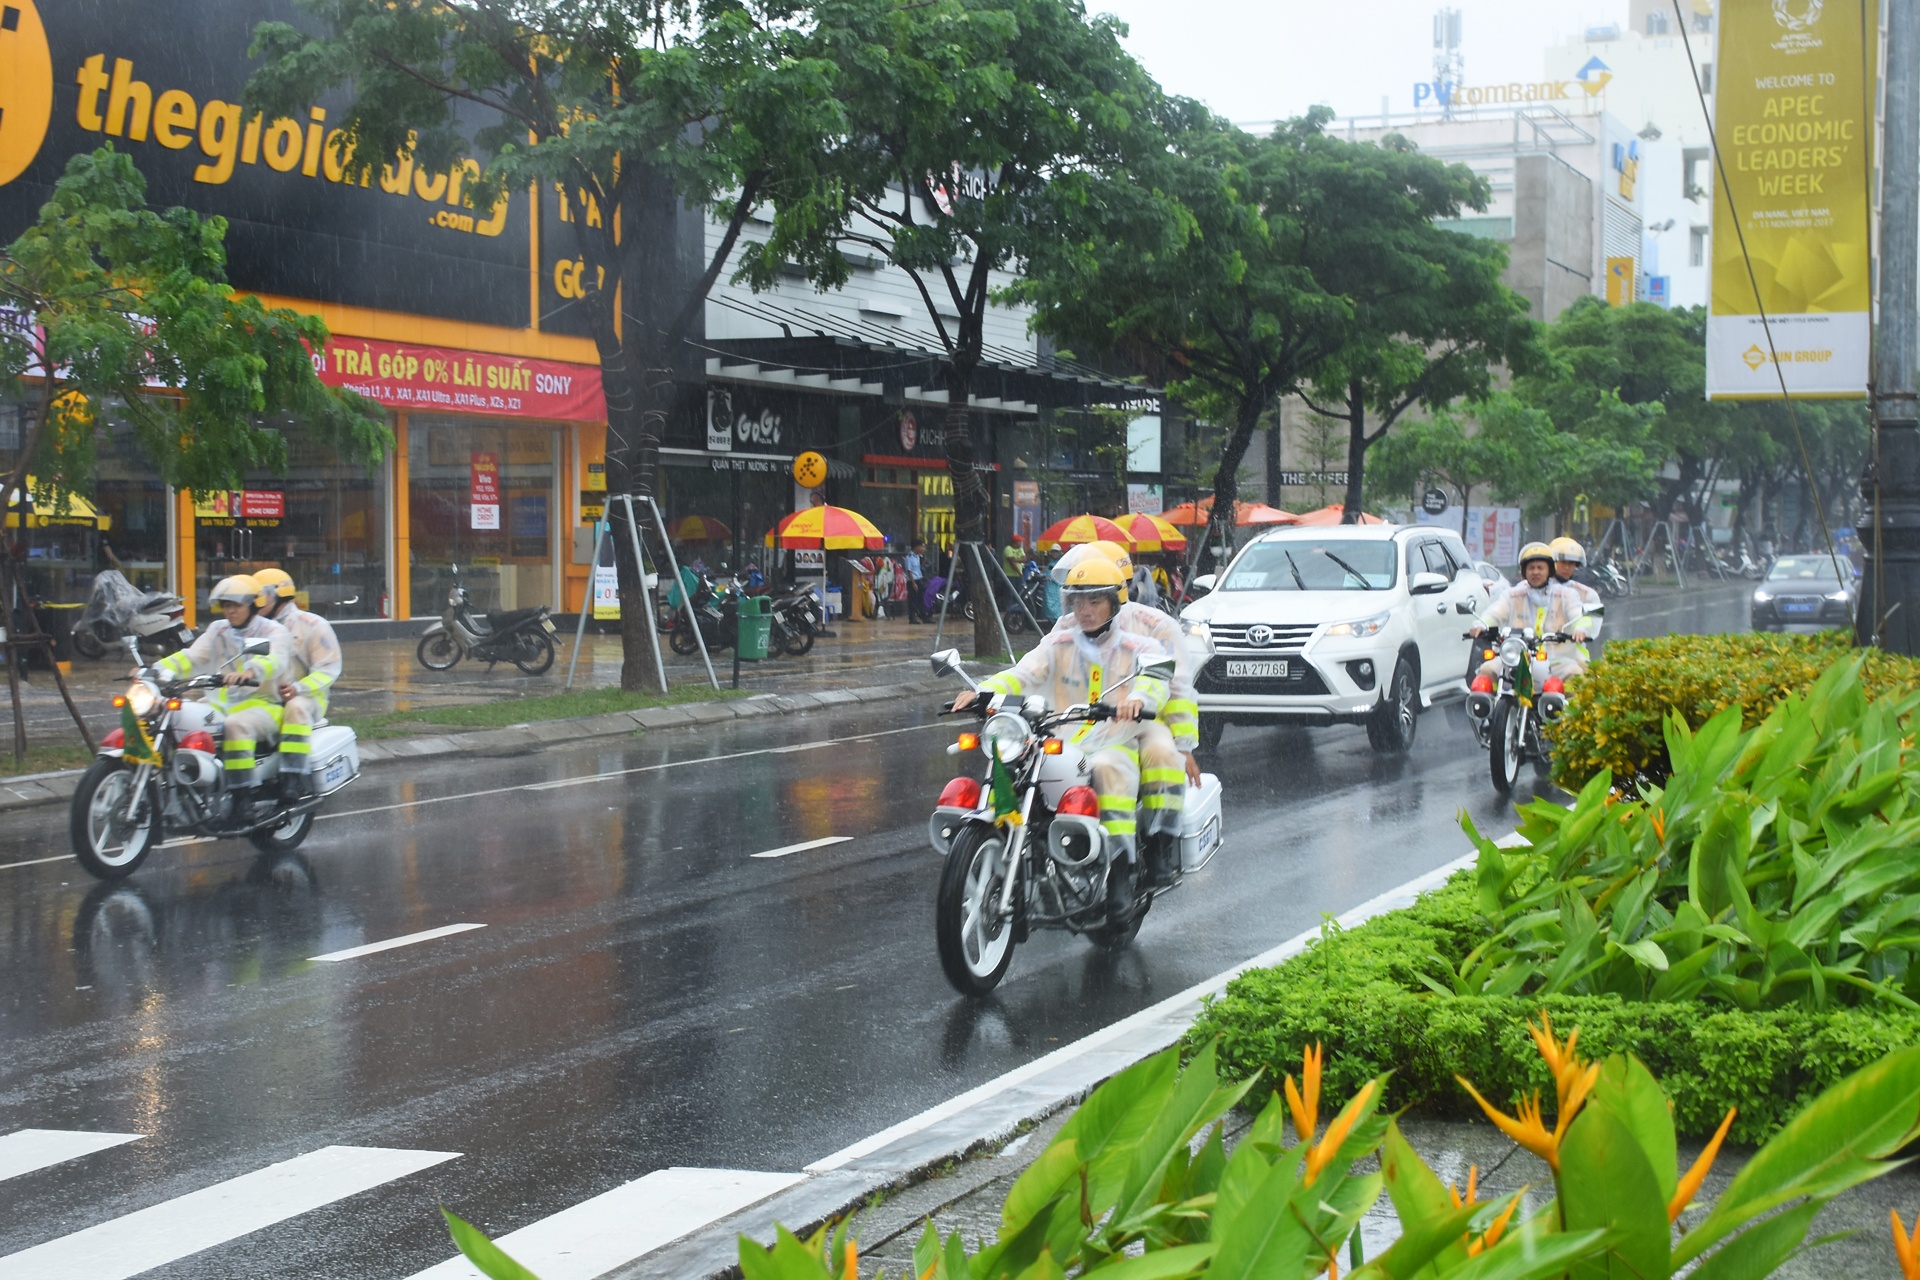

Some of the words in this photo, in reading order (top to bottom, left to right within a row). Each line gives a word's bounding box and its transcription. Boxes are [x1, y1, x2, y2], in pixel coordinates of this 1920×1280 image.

[1756, 75, 1814, 89] WELCOME
[1819, 73, 1835, 85] TO
[1763, 95, 1824, 117] APEC
[1733, 120, 1854, 145] ECONOMIC
[1737, 146, 1848, 171] LEADERS'
[1758, 174, 1825, 196] WEEK
[429, 211, 473, 233] .com
[1769, 351, 1792, 363] SUN
[1795, 350, 1832, 363] GROUP
[332, 343, 373, 376] TRẢ
[378, 349, 418, 380] GÓP
[423, 357, 449, 383] 0%
[453, 357, 482, 387] LÃI
[487, 360, 532, 391] SUẤT
[535, 373, 572, 395] SONY
[1281, 472, 1306, 485] THE
